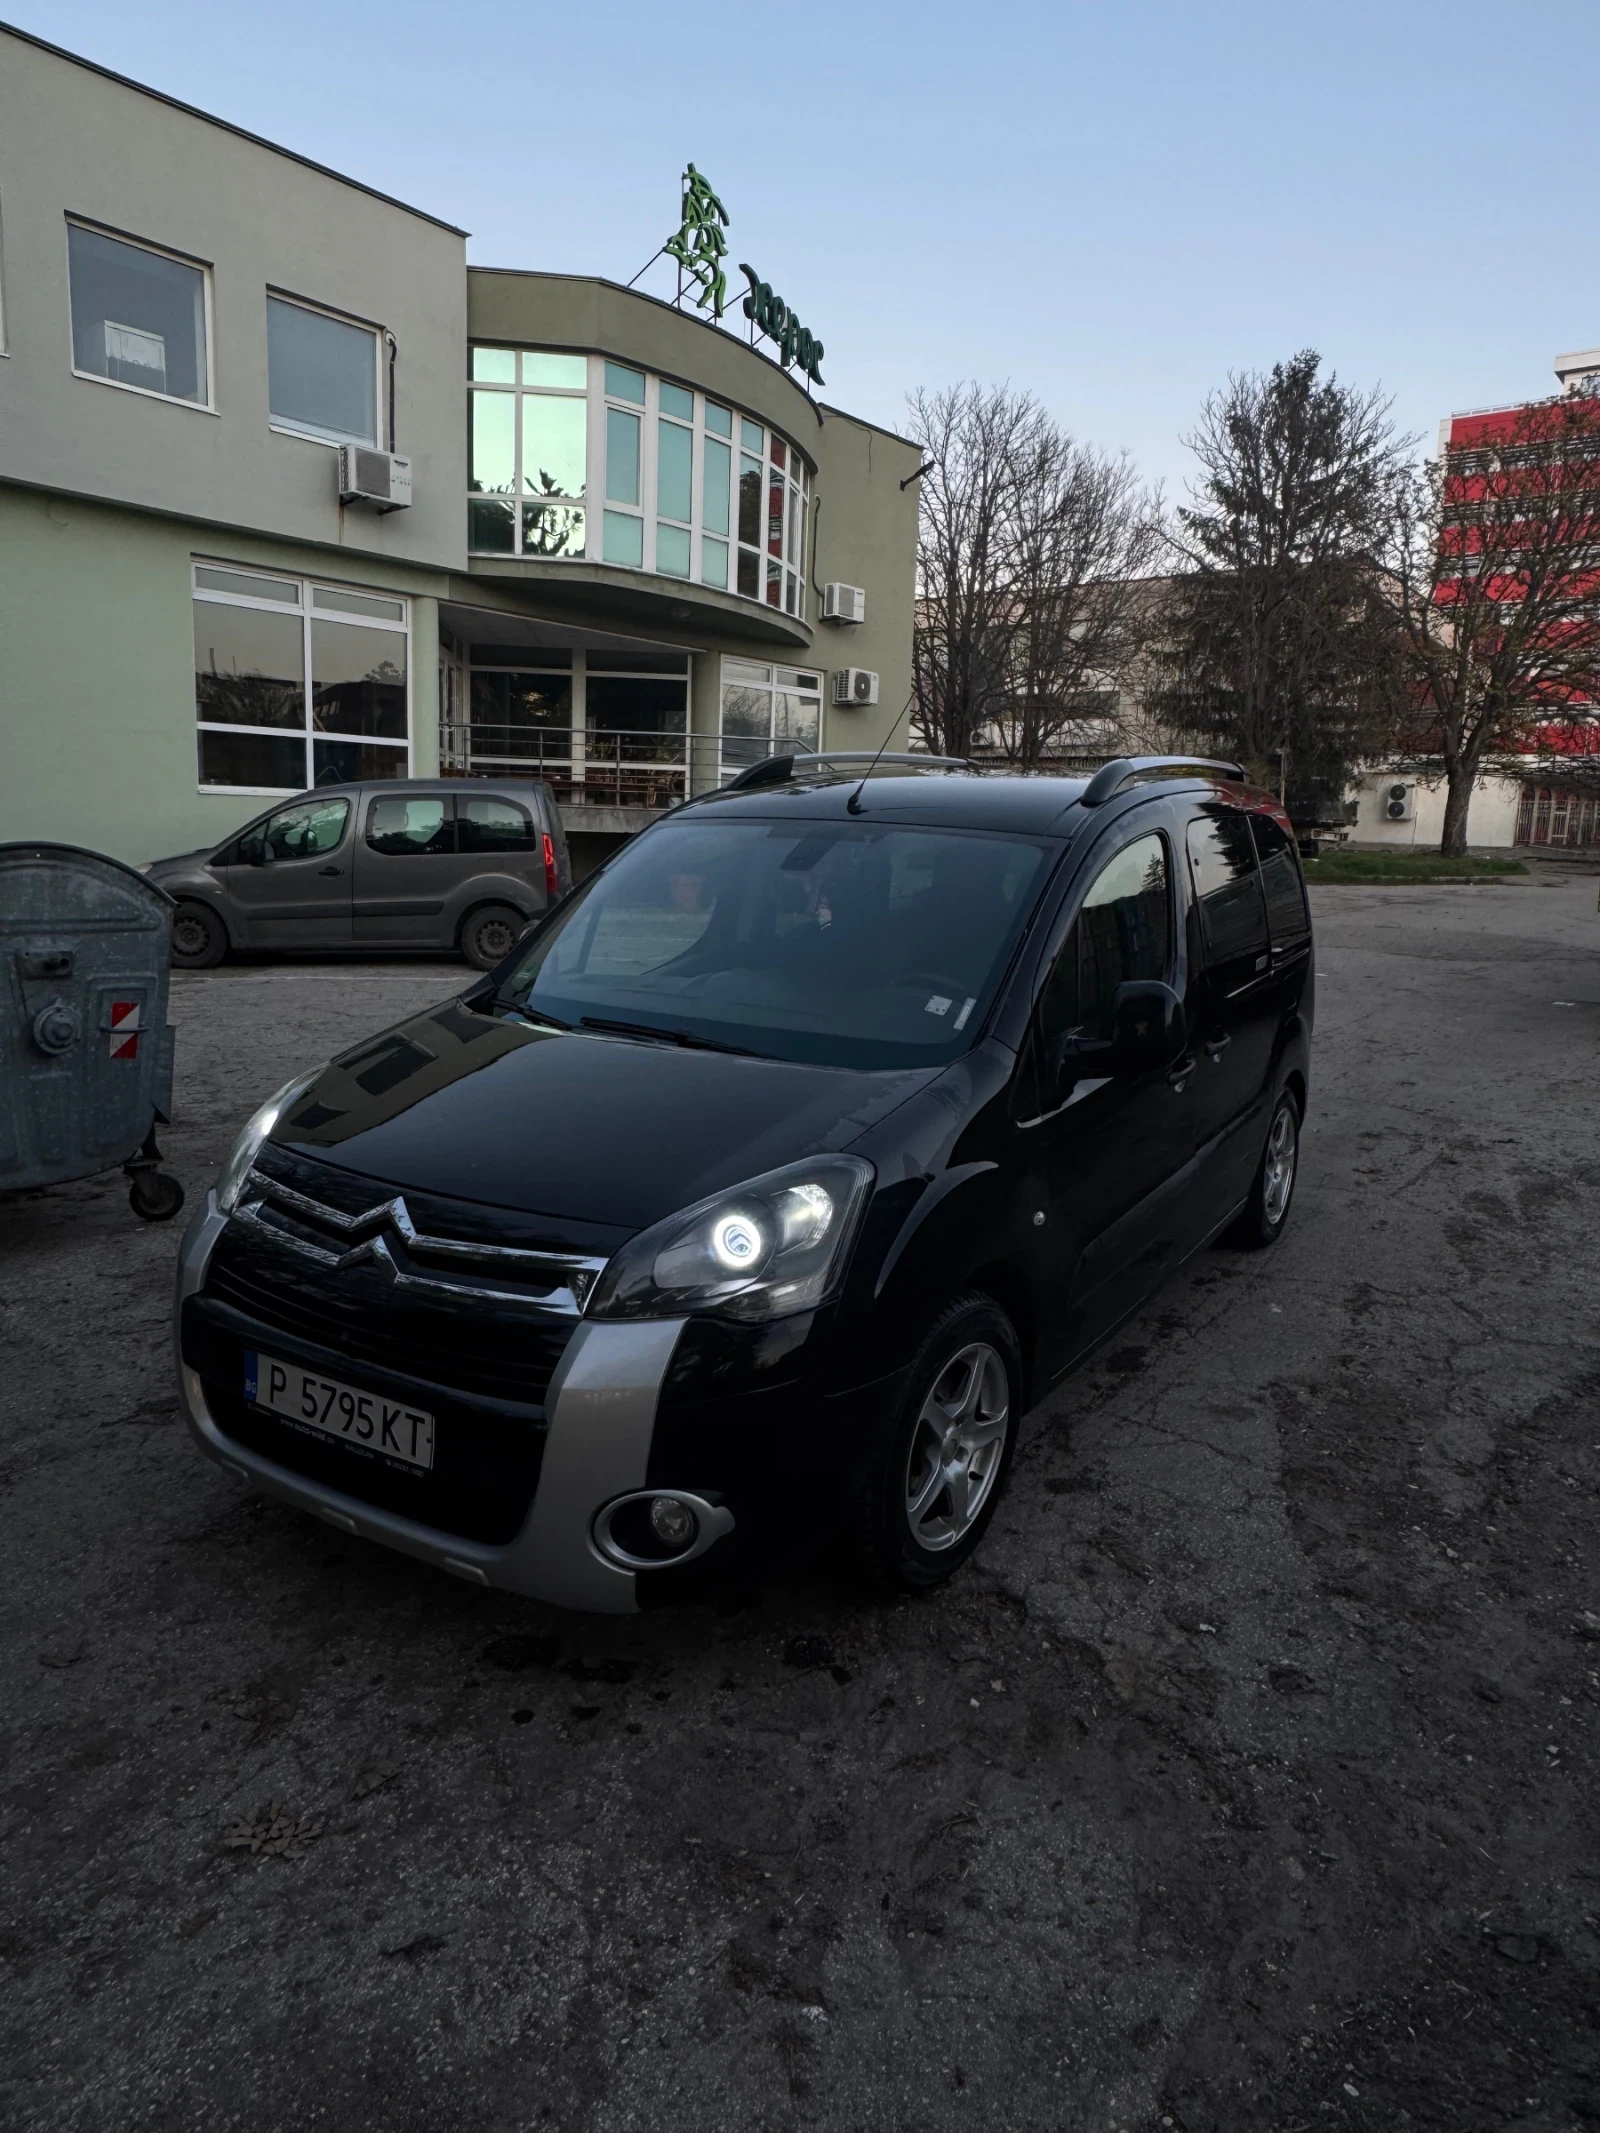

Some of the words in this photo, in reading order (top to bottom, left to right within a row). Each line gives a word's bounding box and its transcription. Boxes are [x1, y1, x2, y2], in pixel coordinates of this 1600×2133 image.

[244, 1378, 257, 1394] BG
[269, 1363, 287, 1404] P
[301, 1375, 374, 1440] 5795
[381, 1404, 426, 1458] KT
